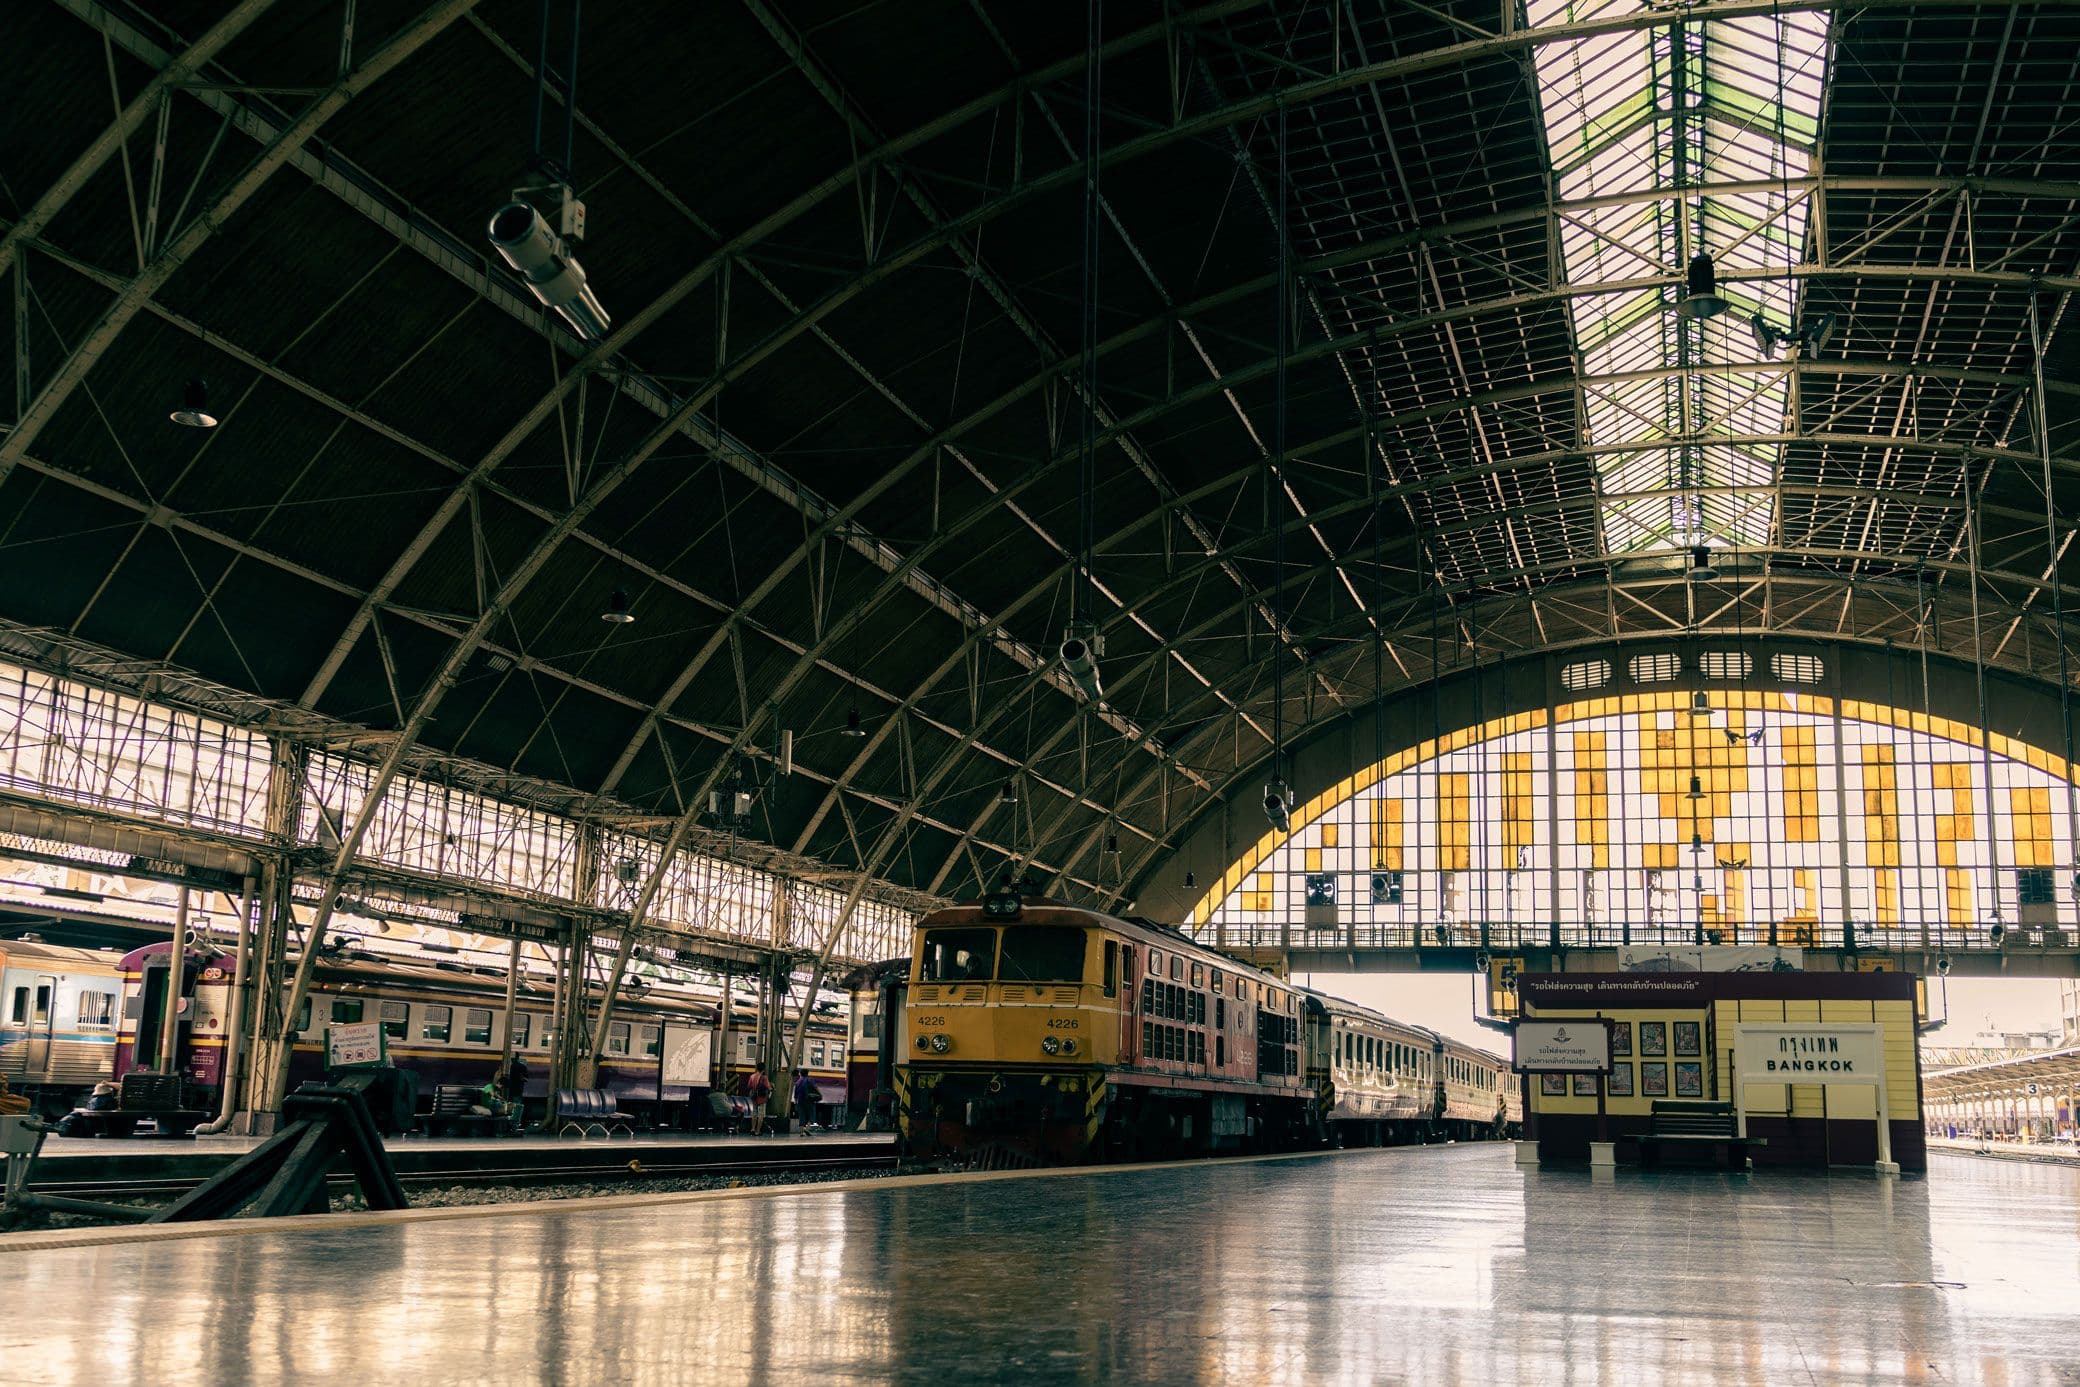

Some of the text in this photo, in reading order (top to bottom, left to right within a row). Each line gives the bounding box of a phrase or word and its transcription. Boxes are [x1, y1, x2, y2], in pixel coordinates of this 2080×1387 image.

[918, 1016, 945, 1026] 4226
[1047, 1019, 1078, 1029] 4226
[1780, 1037, 1838, 1059] กรุงเทพ
[1767, 1060, 1853, 1071] BANGKOK
[2029, 1084, 2037, 1095] 3
